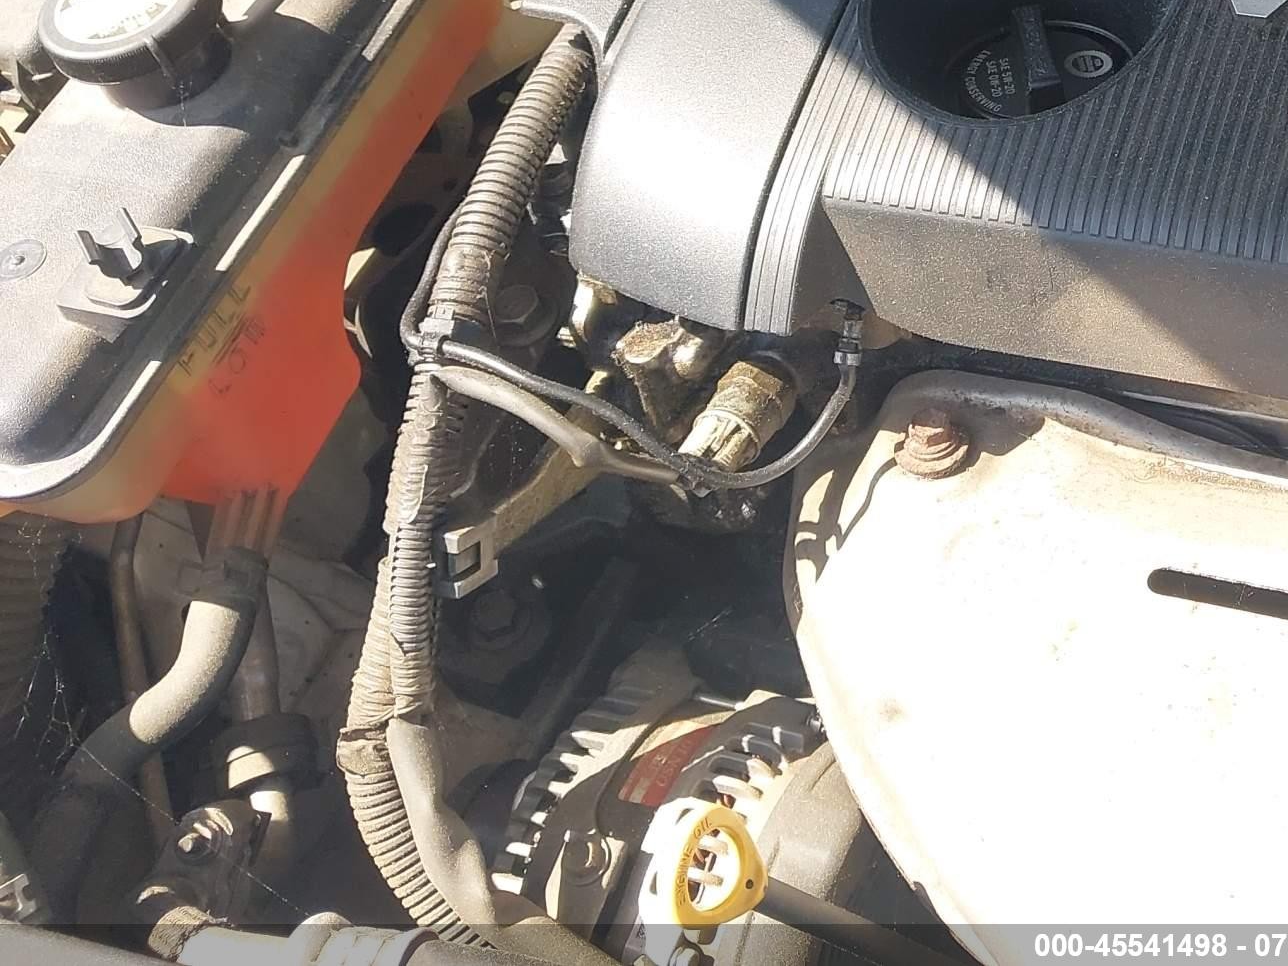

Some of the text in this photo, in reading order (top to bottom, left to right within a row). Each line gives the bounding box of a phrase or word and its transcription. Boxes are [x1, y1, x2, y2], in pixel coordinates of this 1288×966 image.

[176, 285, 252, 377] FULL
[676, 817, 713, 906] ENGINE OIL
